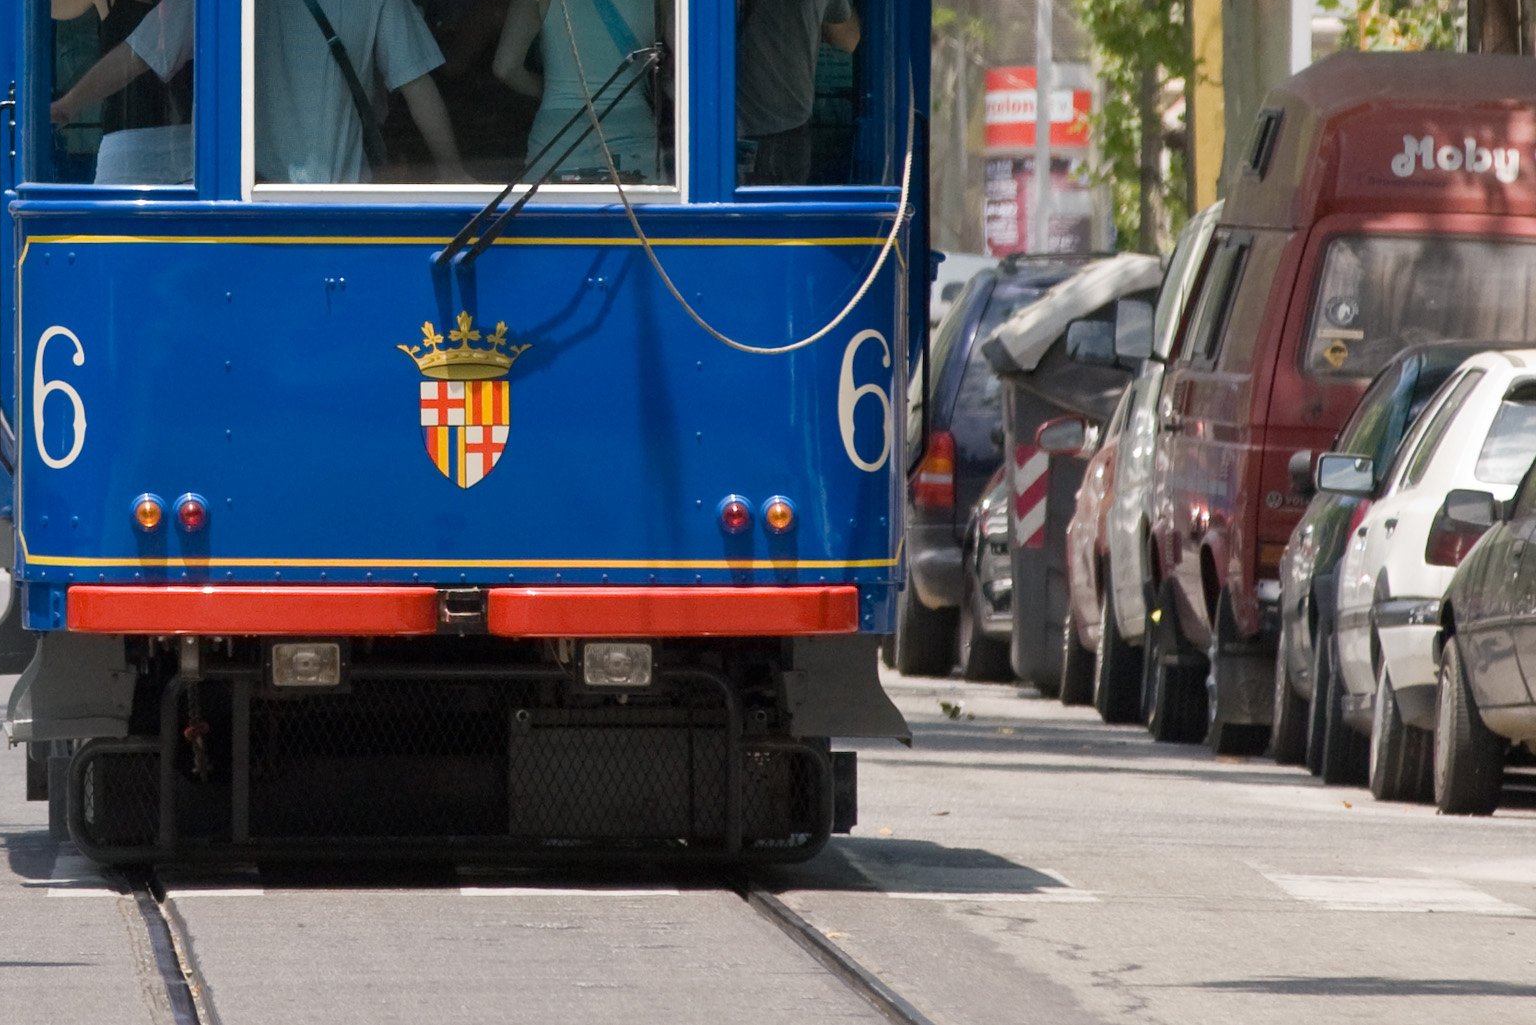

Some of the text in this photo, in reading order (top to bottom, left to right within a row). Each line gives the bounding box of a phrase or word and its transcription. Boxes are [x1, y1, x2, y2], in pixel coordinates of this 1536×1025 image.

[1391, 134, 1520, 184] Moby
[33, 325, 87, 469] 6
[838, 329, 891, 473] 6
